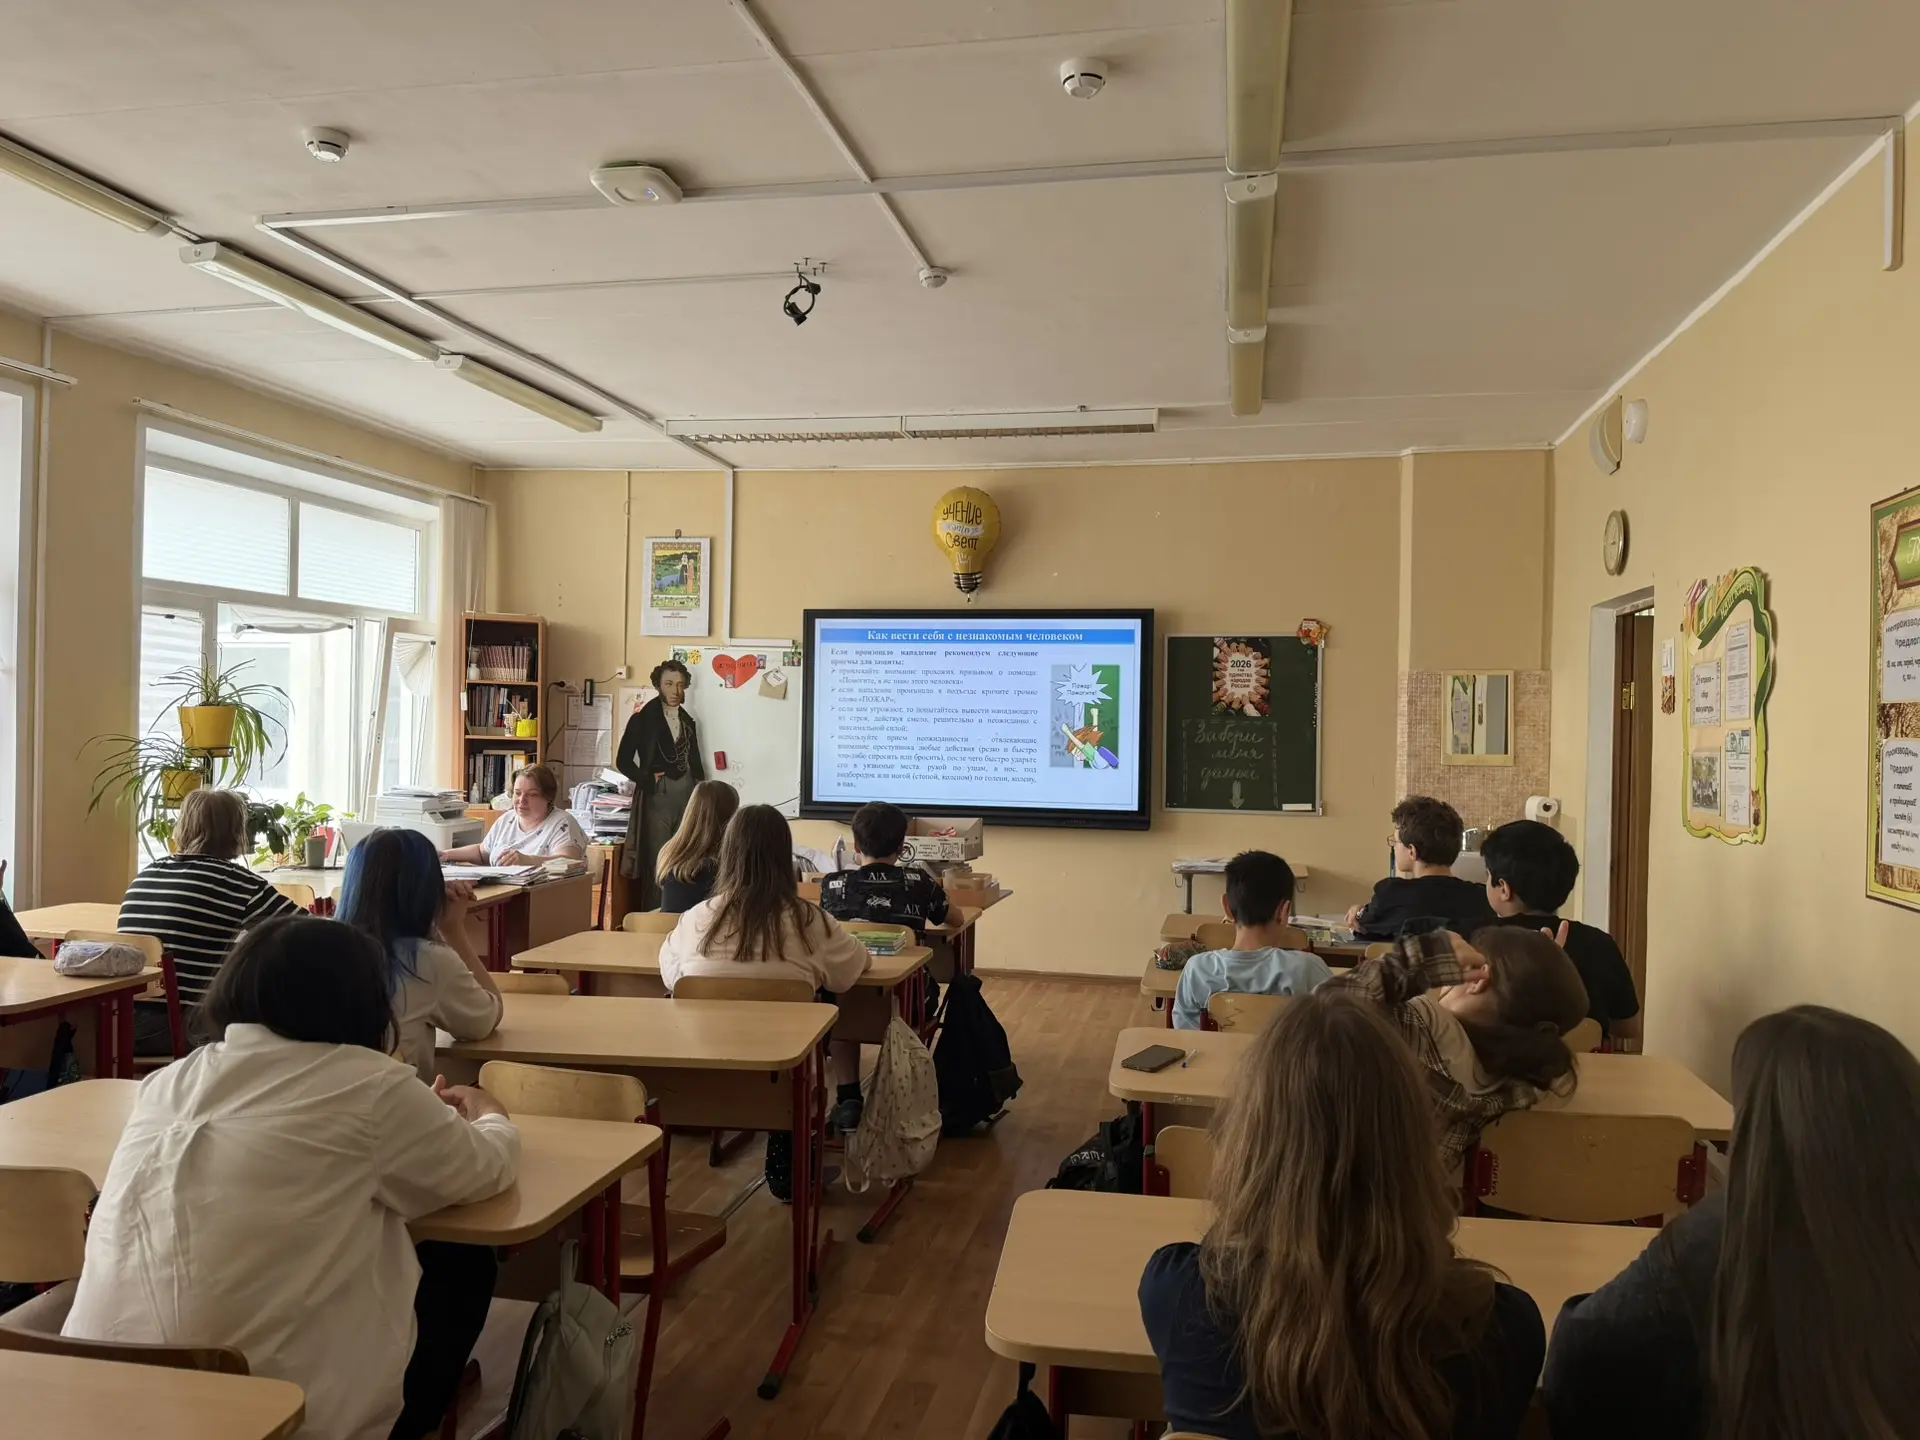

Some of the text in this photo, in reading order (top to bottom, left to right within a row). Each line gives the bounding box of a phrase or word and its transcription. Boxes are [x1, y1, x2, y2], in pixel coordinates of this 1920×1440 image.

[867, 631, 888, 639] Как
[922, 631, 944, 639] себя
[1230, 659, 1252, 668] 2026
